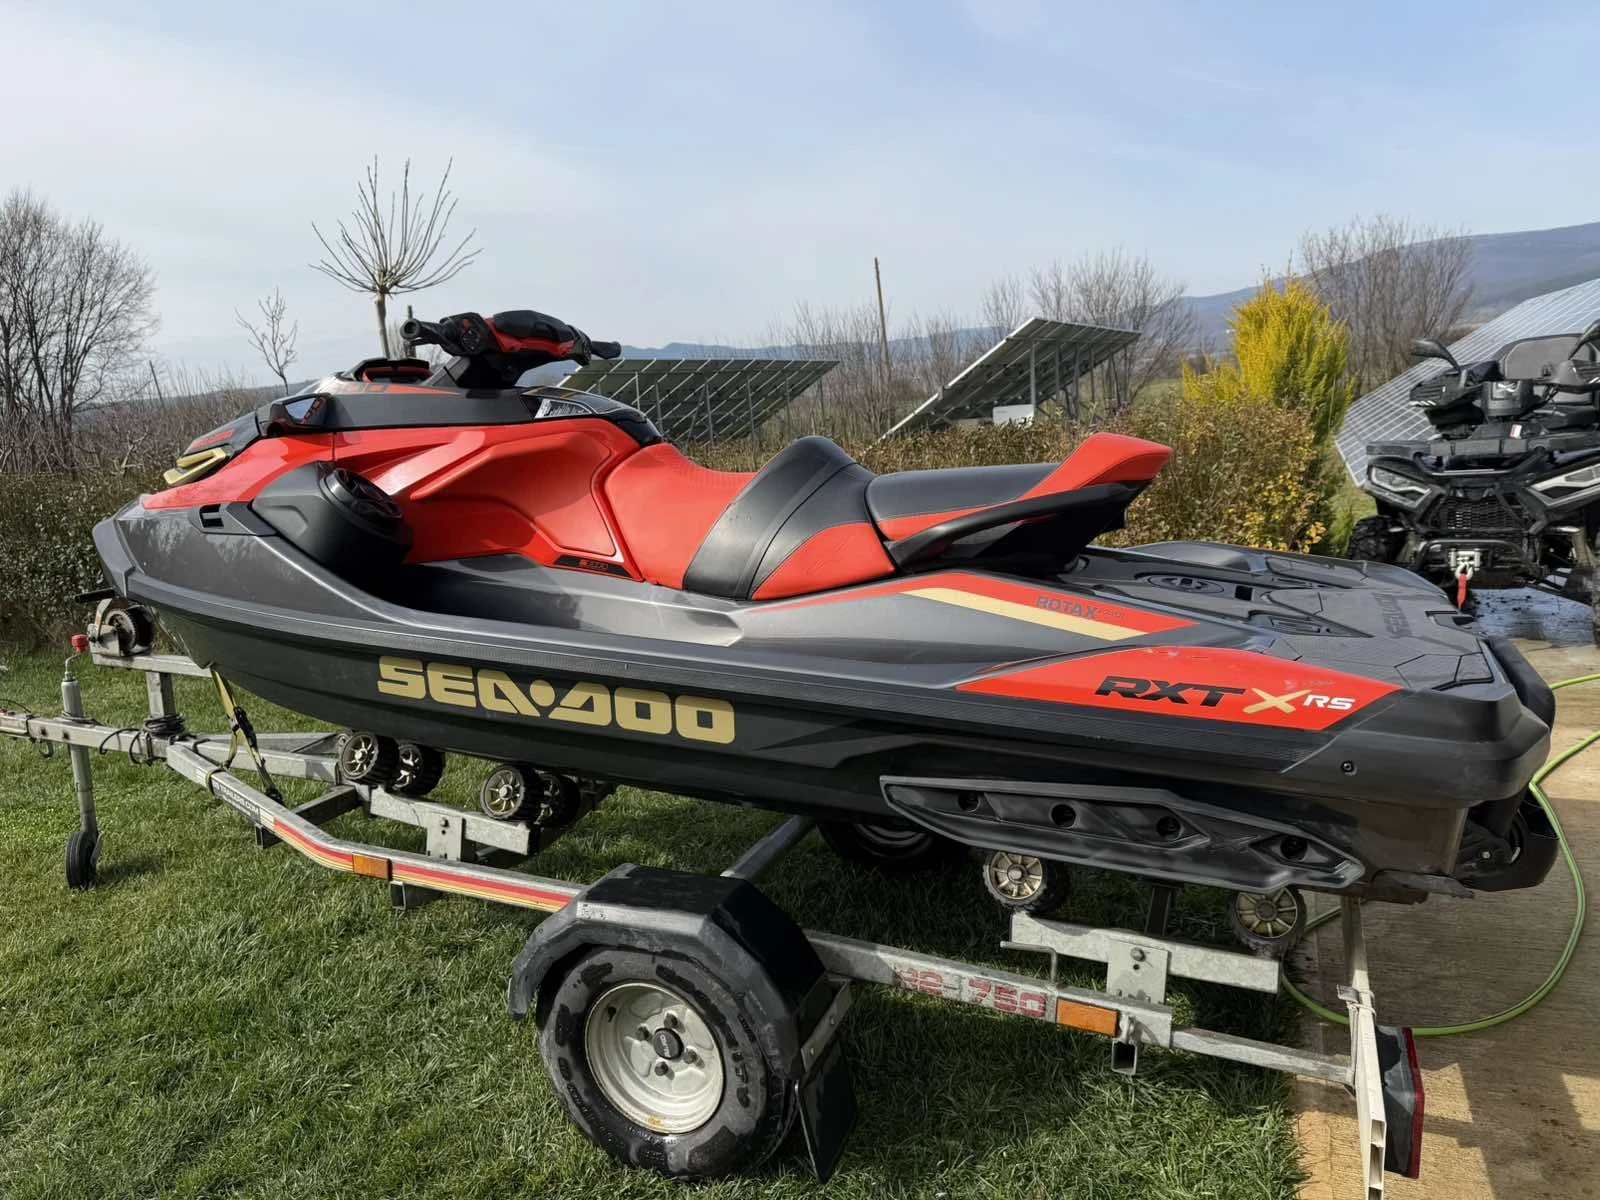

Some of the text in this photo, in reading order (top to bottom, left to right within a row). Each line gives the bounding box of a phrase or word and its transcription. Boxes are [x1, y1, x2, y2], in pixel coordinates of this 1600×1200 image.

[1037, 596, 1098, 619] ROTAX
[1094, 675, 1356, 714] RXT X RS
[968, 977, 1047, 1018] 750
